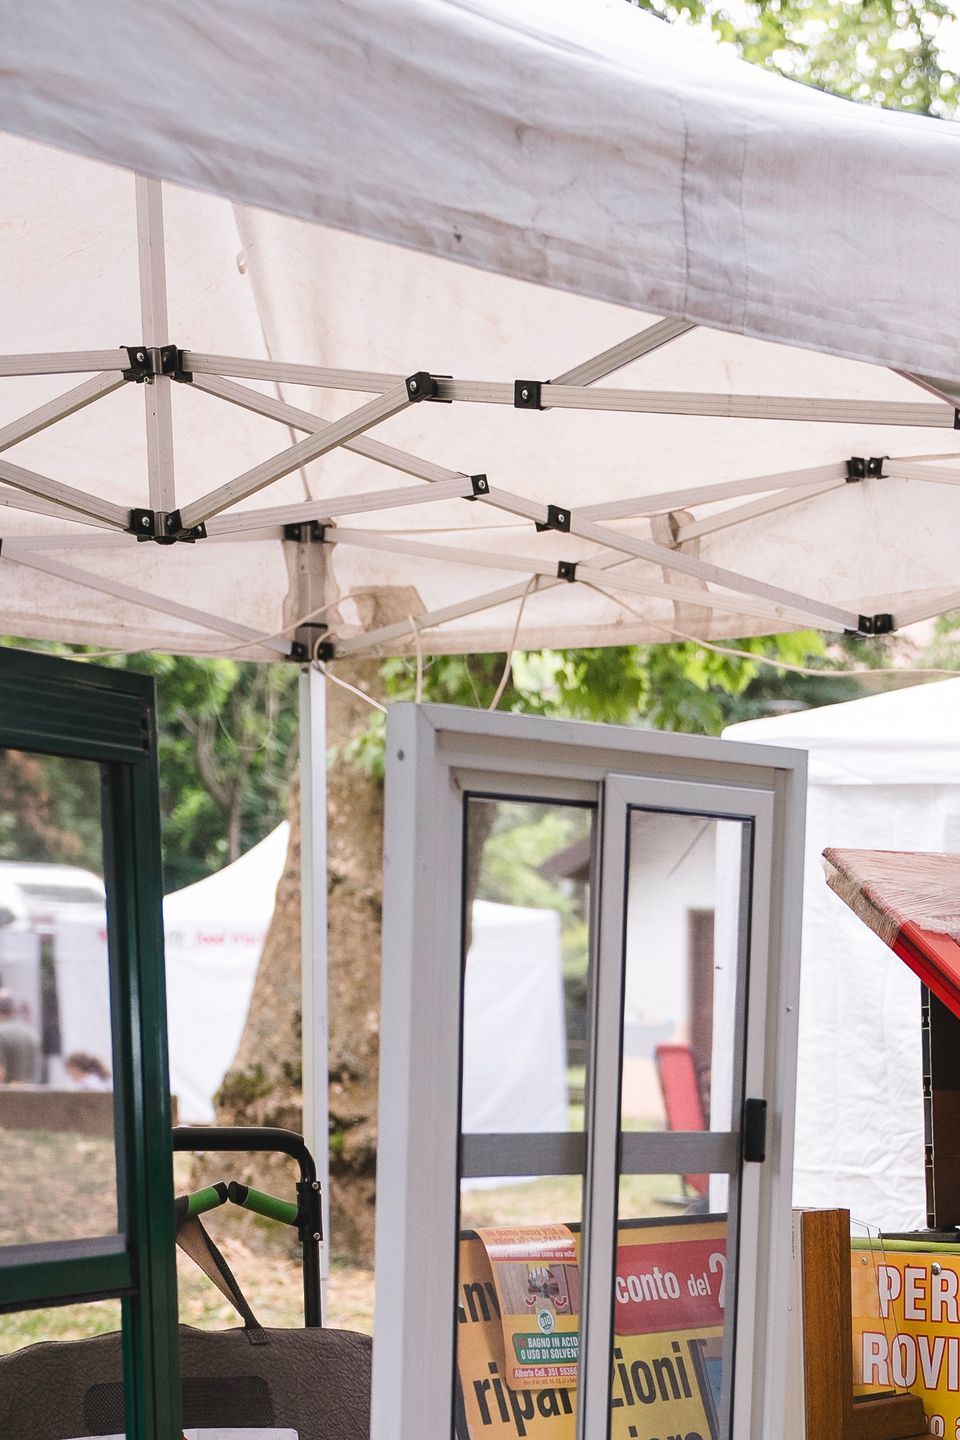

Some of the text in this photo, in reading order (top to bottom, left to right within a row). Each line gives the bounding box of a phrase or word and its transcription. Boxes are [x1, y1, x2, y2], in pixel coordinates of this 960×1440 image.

[687, 1272, 712, 1297] del
[528, 1337, 551, 1349] BAGNO
[552, 1337, 561, 1347] IN
[527, 1349, 541, 1360] USO
